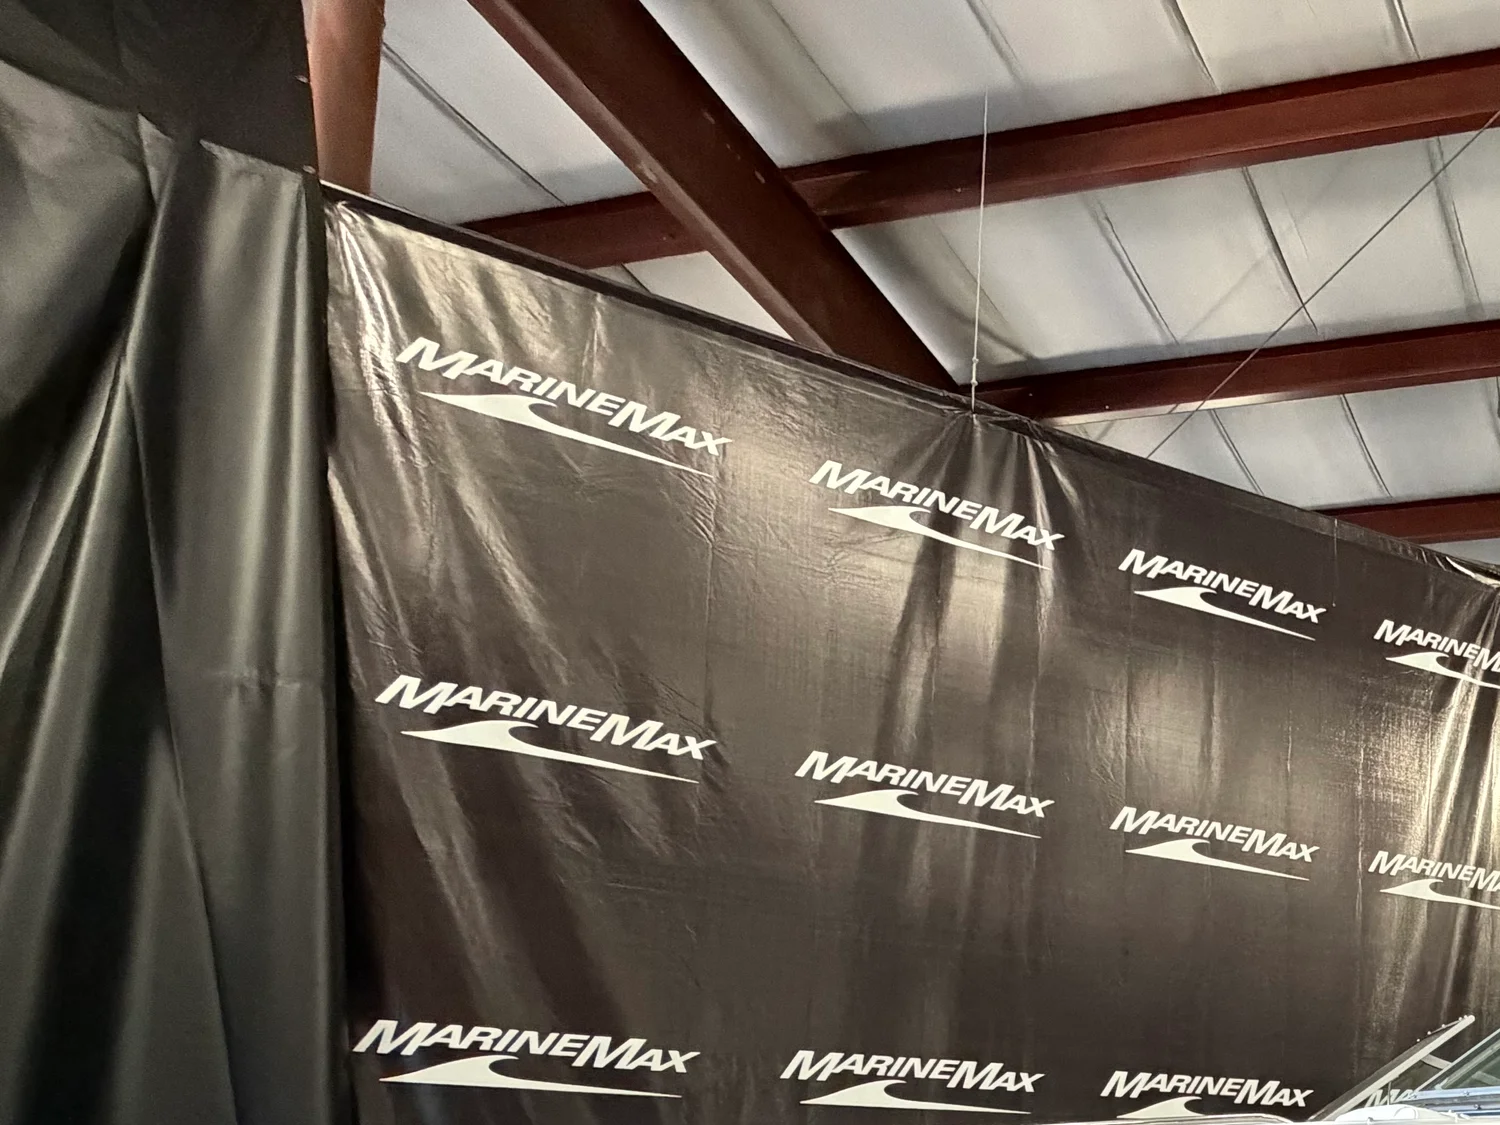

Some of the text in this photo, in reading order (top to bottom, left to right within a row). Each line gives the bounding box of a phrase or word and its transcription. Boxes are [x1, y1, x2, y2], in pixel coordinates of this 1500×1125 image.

[395, 336, 733, 457] MARINEMAX
[809, 459, 1065, 551] MARINEMAX
[1119, 548, 1327, 624] MARINEMAX
[375, 674, 717, 760] MARINEMAX
[794, 750, 1055, 818] MARINEMAX
[1109, 805, 1320, 863] MARINEMAX
[353, 1019, 701, 1073] MARINEMAX
[780, 1050, 1045, 1093] MARINEMAX
[1101, 1070, 1314, 1107] MARINEMAX
